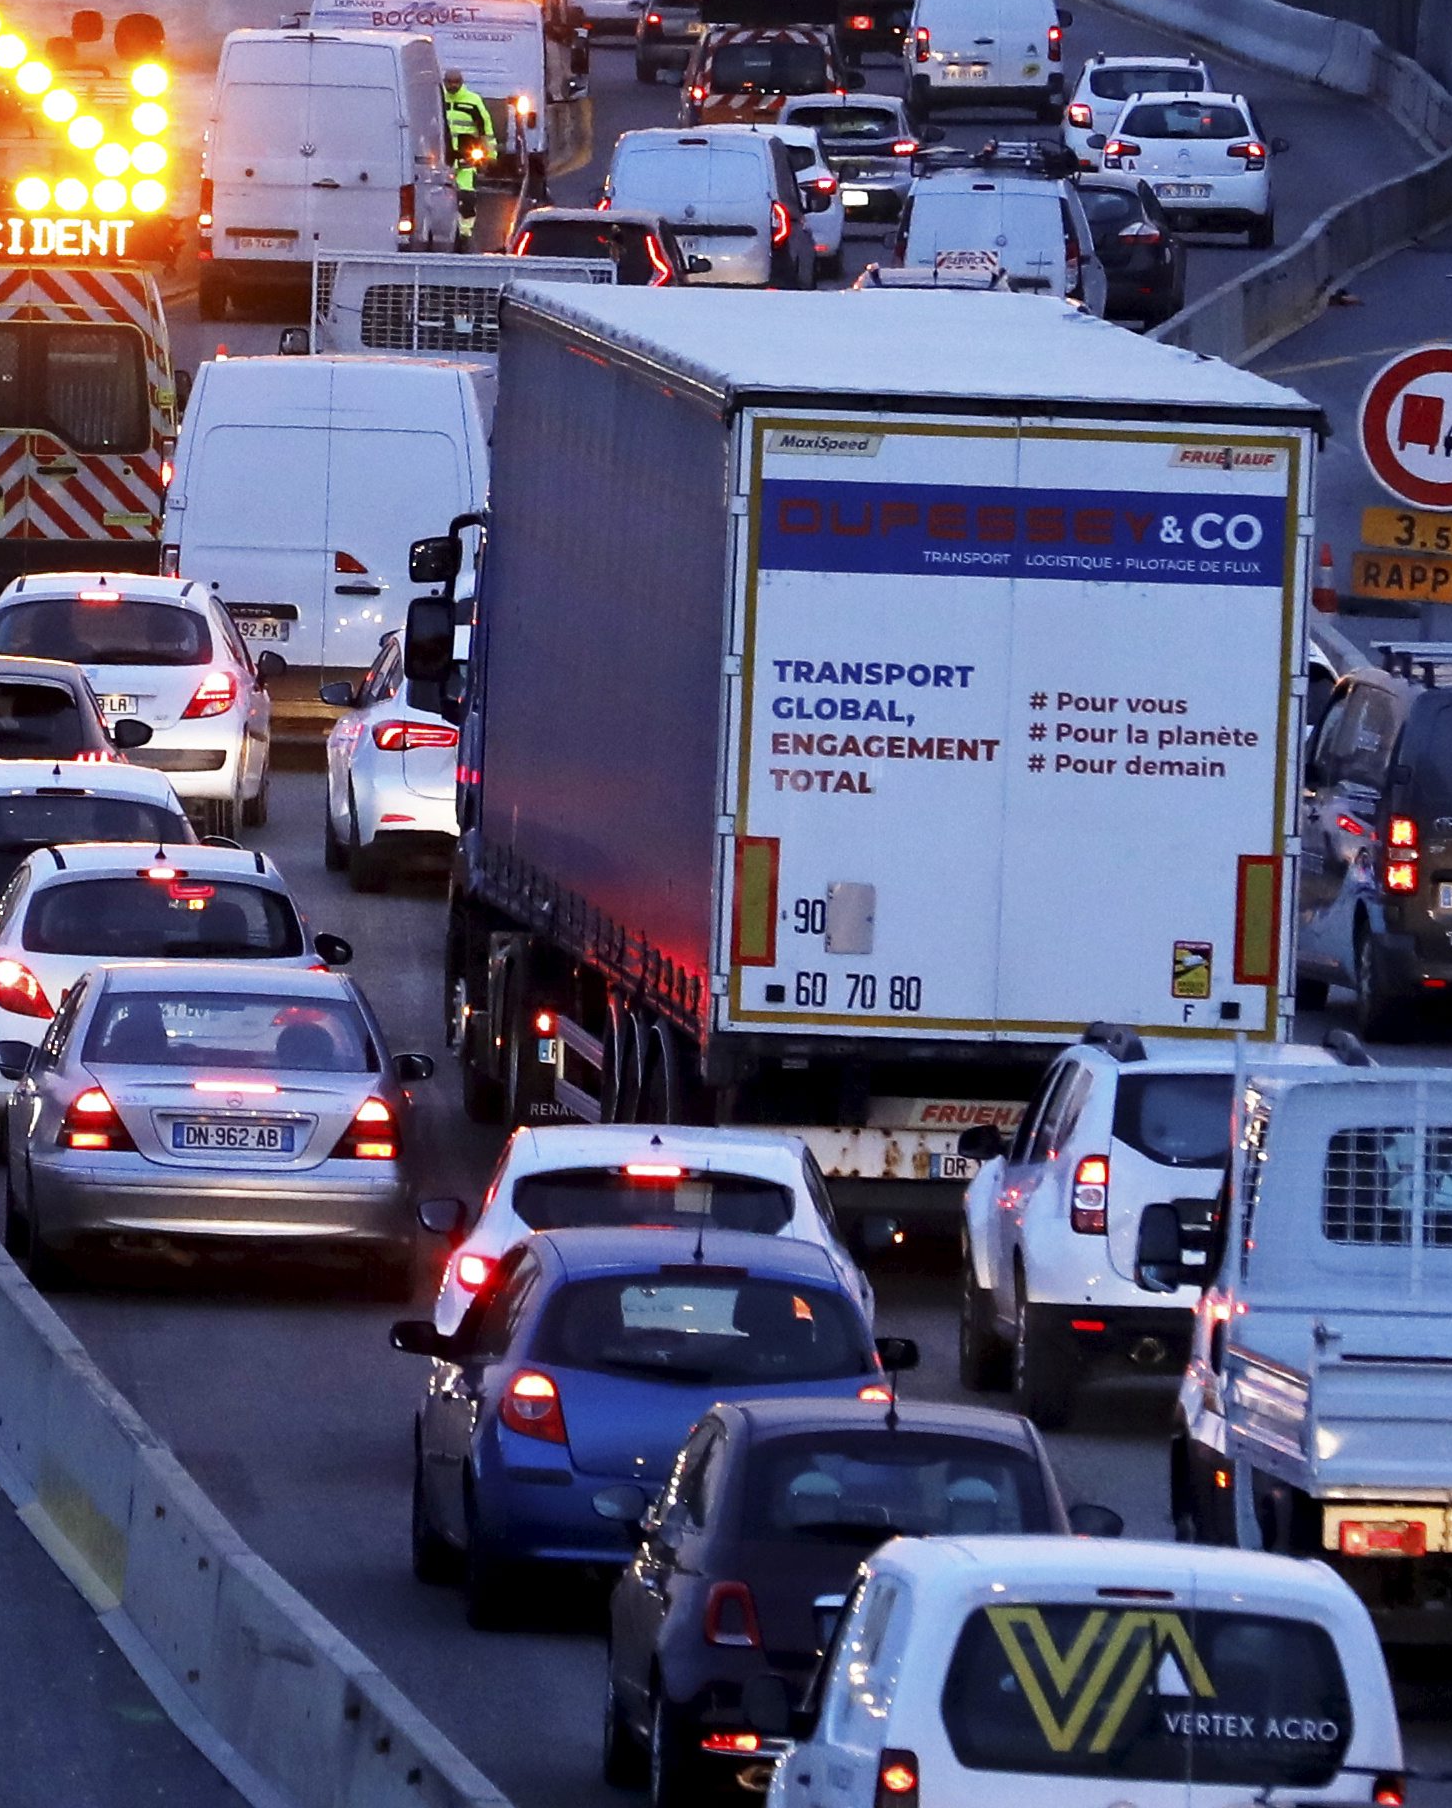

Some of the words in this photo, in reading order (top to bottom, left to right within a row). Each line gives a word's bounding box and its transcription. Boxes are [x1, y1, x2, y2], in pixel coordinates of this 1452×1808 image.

[371, 7, 480, 27] BOCQUET
[780, 435, 870, 452] MaxiSpeed
[923, 550, 1011, 565] TRANSPORT
[1025, 554, 1112, 569] LOGISTIQUE
[1125, 558, 1196, 572] PILOTAGE
[1200, 561, 1220, 573] DE
[1224, 561, 1262, 574] FLUX
[772, 659, 975, 688] TRANSPORT
[772, 696, 916, 727] GLOBAL,
[1057, 691, 1119, 714] Pour
[1126, 697, 1188, 714] vous
[771, 732, 1001, 761] ENGAGEMENT
[1055, 722, 1118, 743] Pour
[1126, 723, 1149, 744] la
[1157, 725, 1259, 750] planète
[1054, 753, 1118, 774] Pour
[1125, 755, 1226, 777] demain
[769, 768, 875, 794] TOTAL
[794, 898, 827, 935] 90
[795, 971, 828, 1007] 60
[845, 973, 877, 1010] 70
[889, 975, 922, 1011] 80
[1183, 1004, 1195, 1023] F
[185, 1126, 279, 1148] DN-962-AB
[1163, 1712, 1255, 1738] VERTEX
[1263, 1718, 1339, 1744] ACRO
